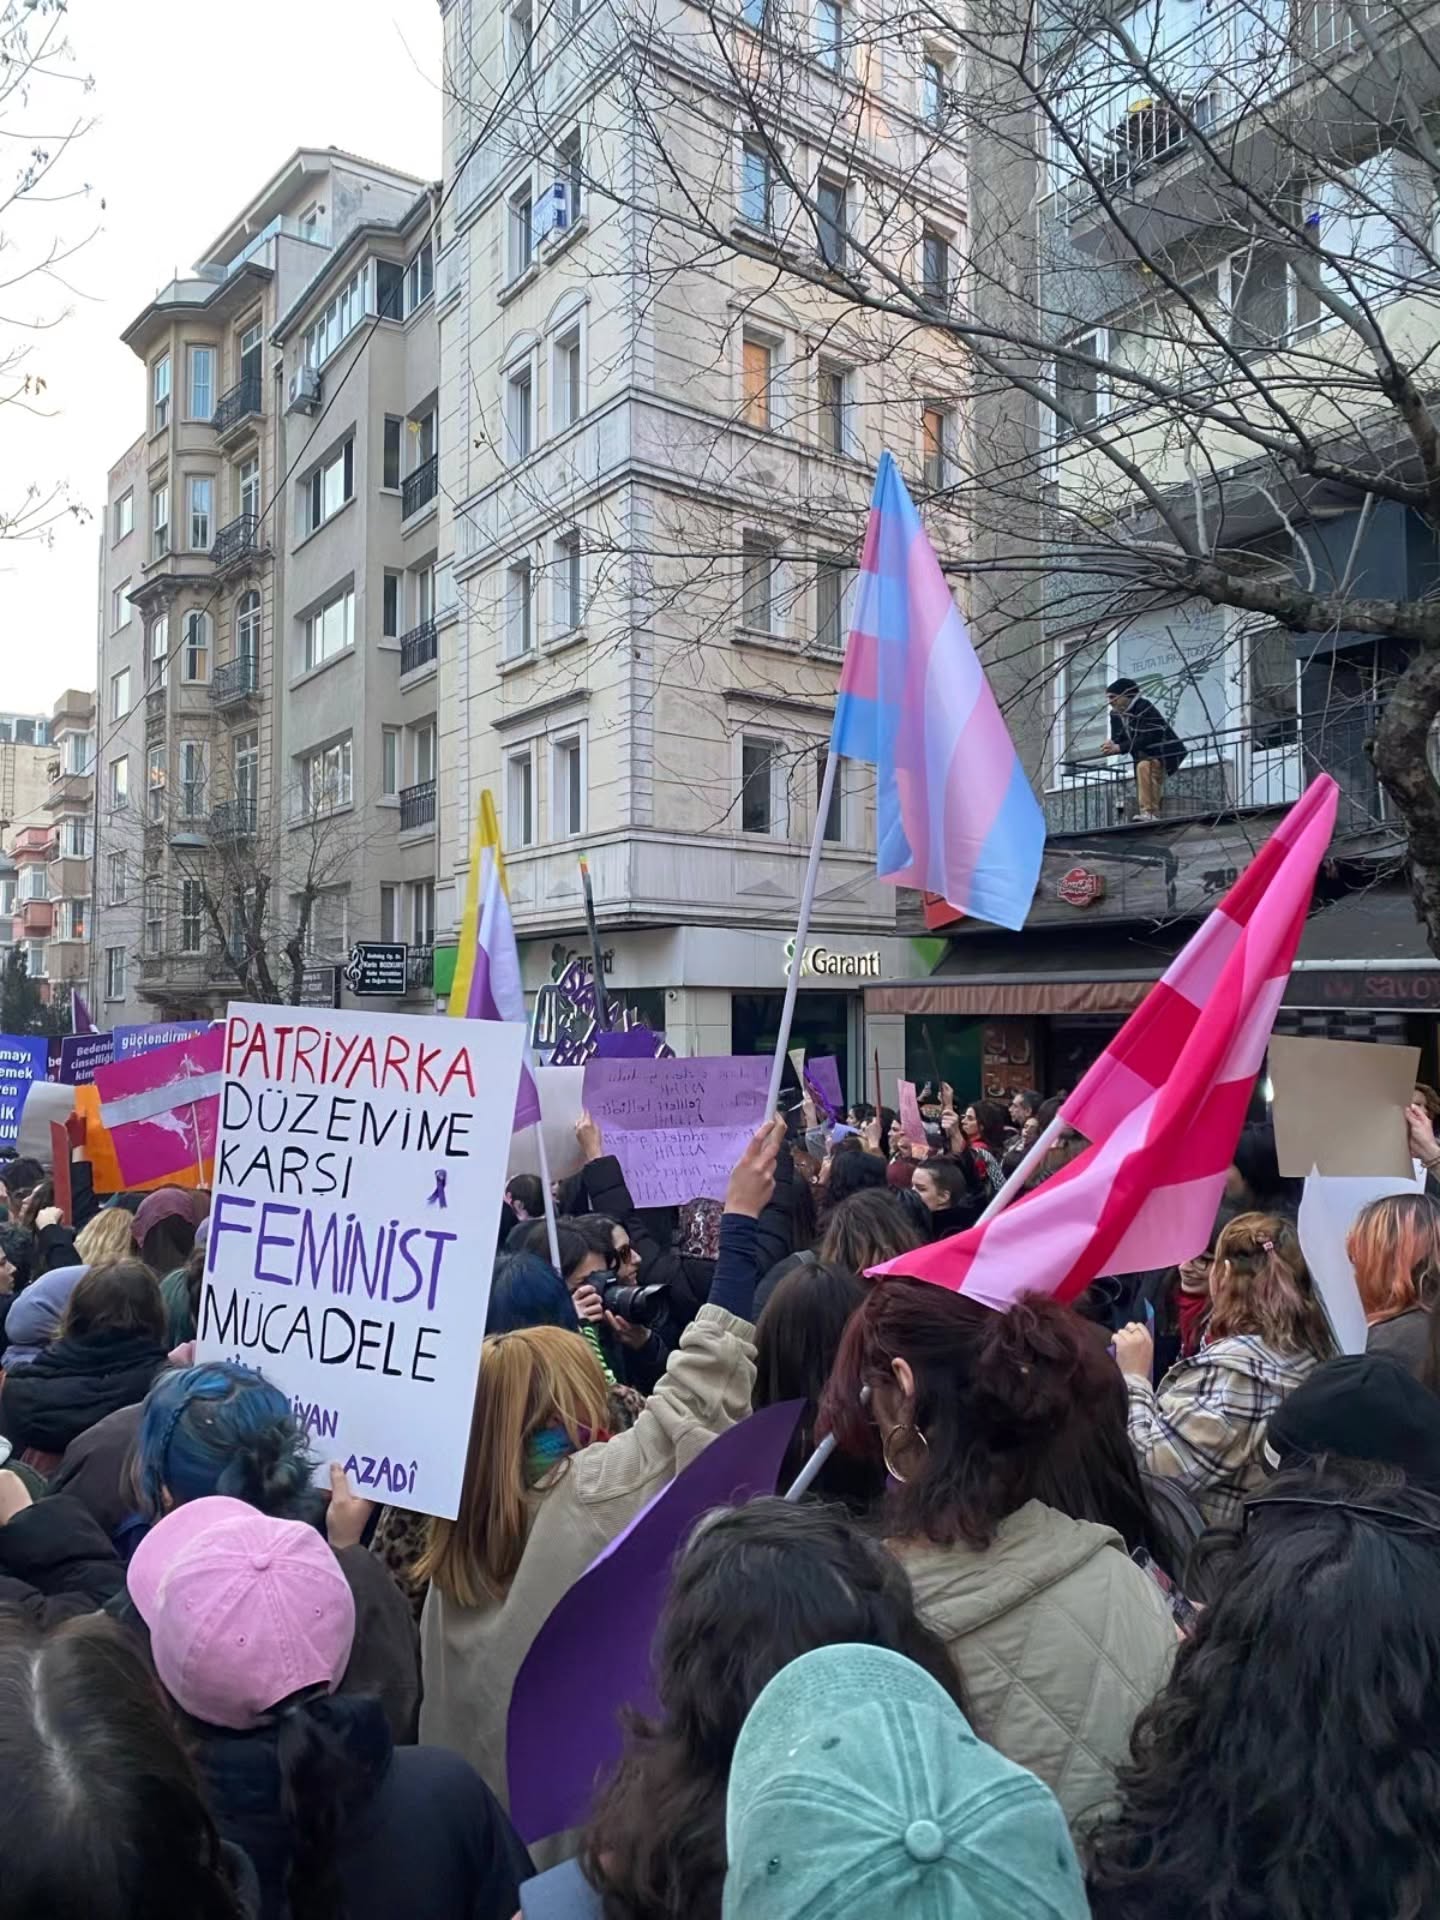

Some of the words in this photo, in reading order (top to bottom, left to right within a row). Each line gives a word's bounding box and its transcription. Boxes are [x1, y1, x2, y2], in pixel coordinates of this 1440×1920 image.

[811, 946, 881, 976] Garanti
[226, 1017, 476, 1098] PATRİYARKA
[222, 1081, 473, 1157] DÜZENİNE
[219, 1140, 352, 1198] KARŞI
[208, 1193, 457, 1310] FEMİNİST
[202, 1284, 441, 1382] MÜCADELE
[288, 1395, 338, 1438] İYAN
[344, 1454, 418, 1494] AZADÎ
